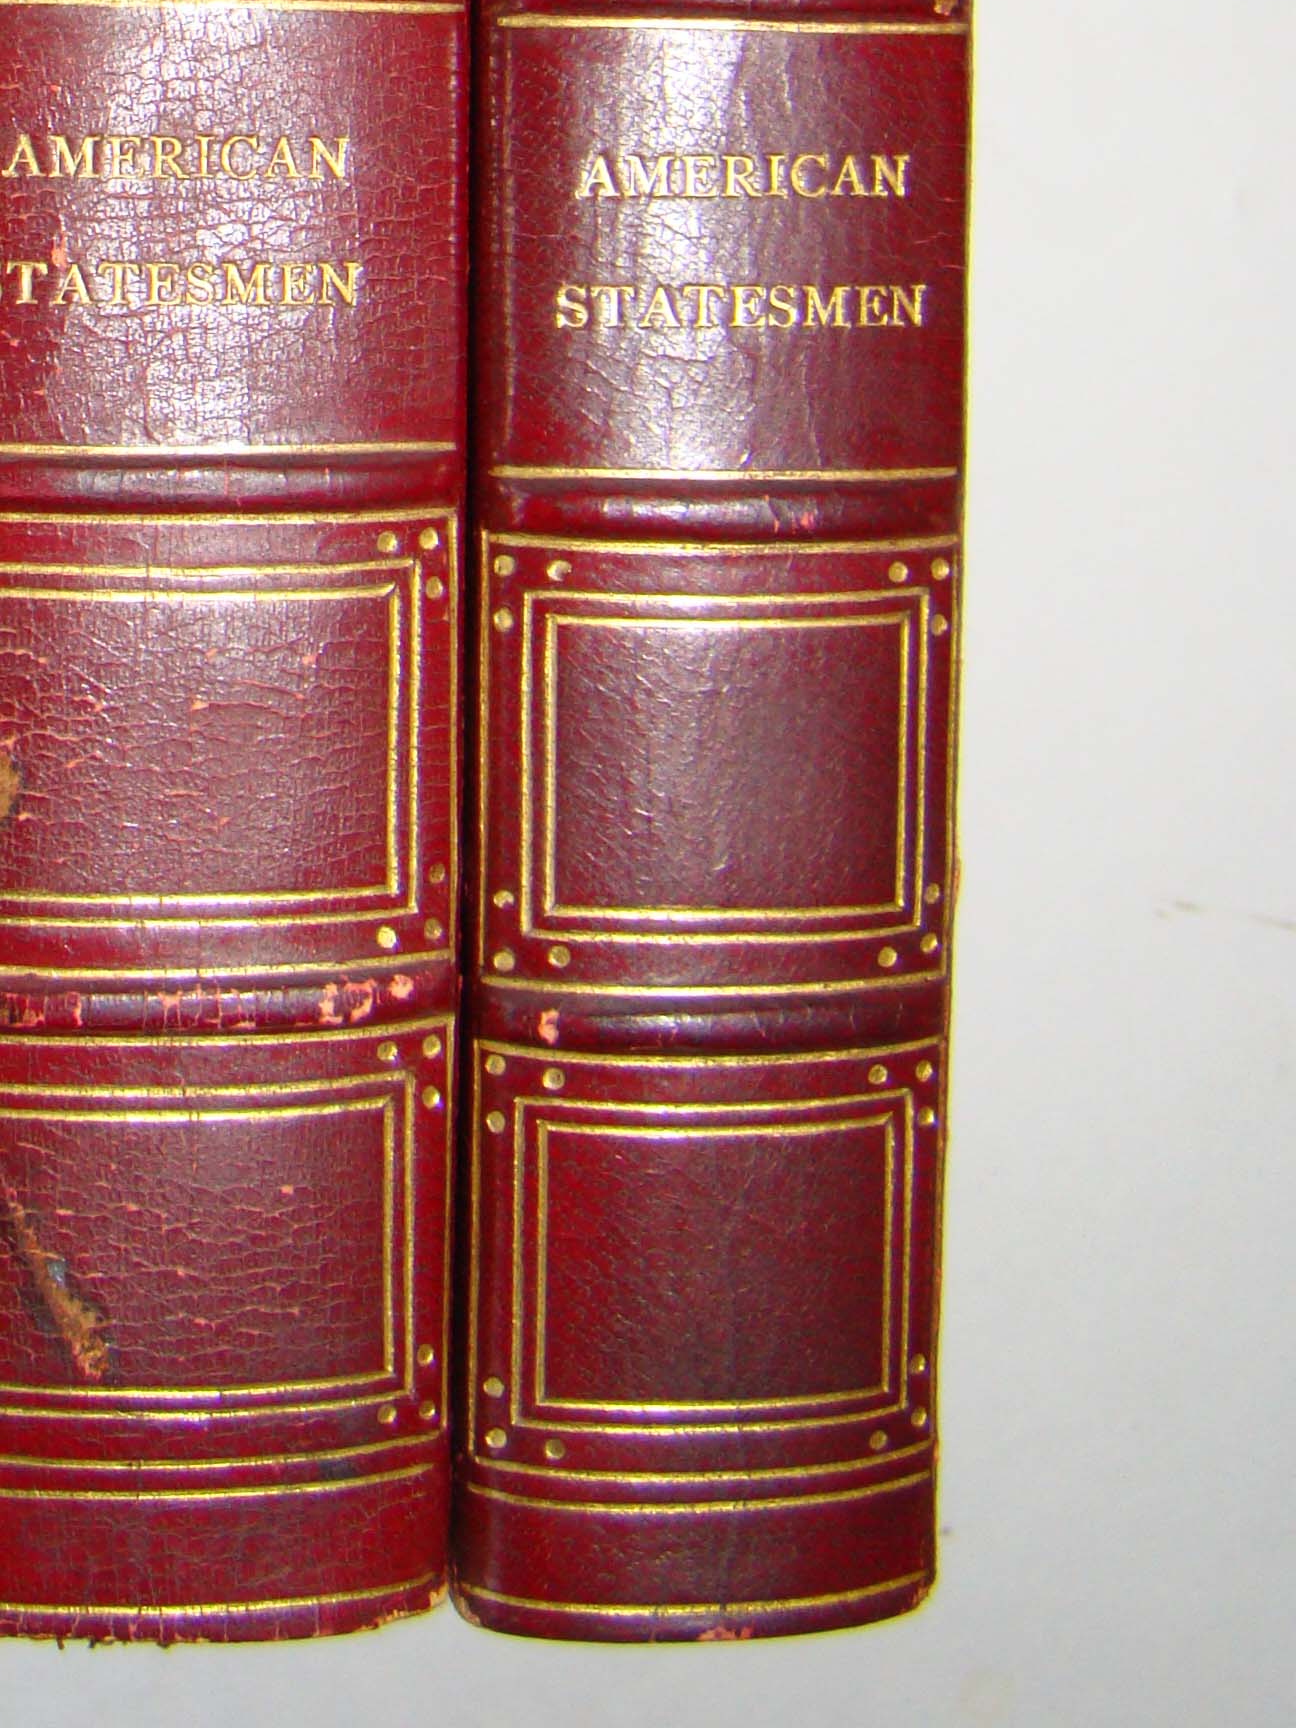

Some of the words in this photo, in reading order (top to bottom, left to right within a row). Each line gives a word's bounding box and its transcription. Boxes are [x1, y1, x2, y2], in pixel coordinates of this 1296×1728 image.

[2, 134, 349, 180] AMERICAN
[574, 154, 910, 200] AMERICAN
[556, 283, 927, 329] STATESMEN
